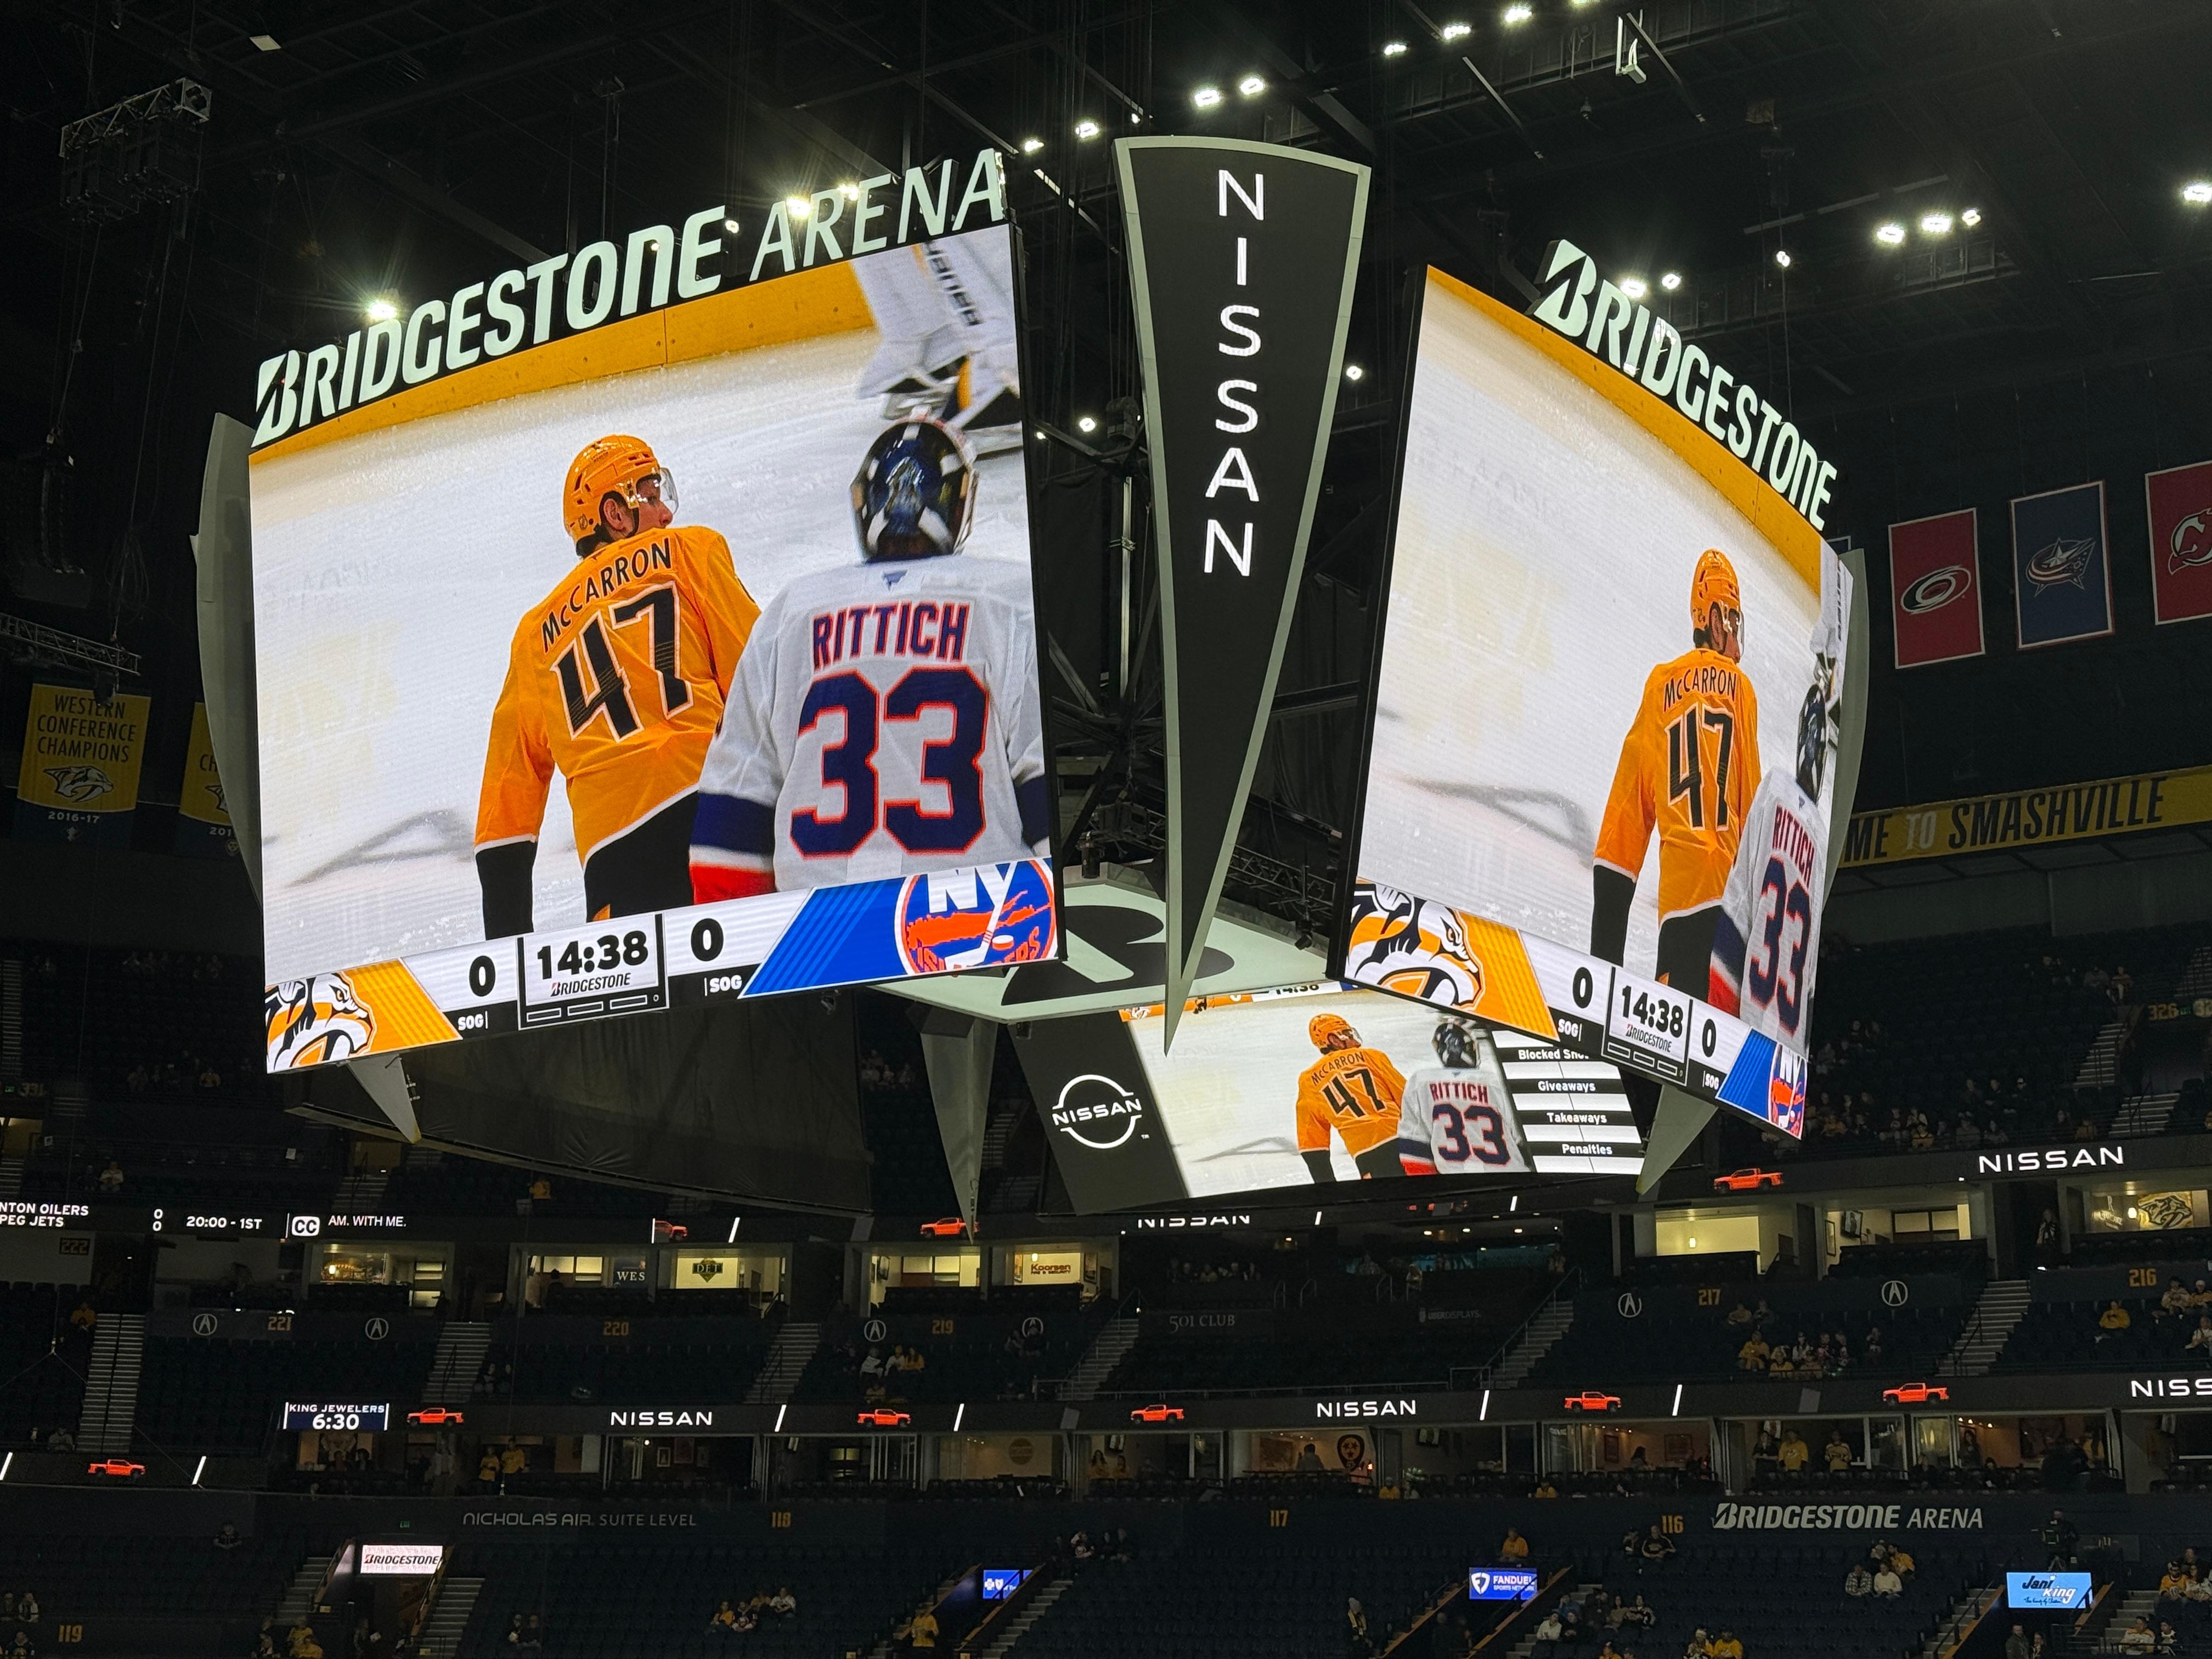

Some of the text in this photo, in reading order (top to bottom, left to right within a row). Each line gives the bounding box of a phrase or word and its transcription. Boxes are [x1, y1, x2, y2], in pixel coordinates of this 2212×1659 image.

[251, 206, 726, 448] BRIDGESTONE
[749, 148, 1005, 282] ARENA
[1204, 170, 1265, 577] NISSAN
[1531, 239, 1837, 531] BRIDGESTONE
[812, 601, 970, 670] RITTICH
[551, 581, 693, 741] 47
[37, 714, 137, 741] CONFERENCE
[37, 737, 130, 762] CHAMPIONS
[790, 665, 989, 859] 33
[1664, 702, 1734, 831] 47
[48, 811, 100, 823] 2016-17
[1905, 811, 1937, 851] TO
[1949, 776, 2168, 849] SMASHVILLE
[1772, 803, 1815, 889] RITTICH
[690, 918, 724, 962] 0
[1749, 854, 1810, 1037] 33
[537, 931, 648, 980] 14:38
[469, 956, 495, 997] 0
[550, 973, 631, 997] BRIDGESTONE
[709, 975, 742, 993] SOG
[1572, 967, 1593, 1008] 0
[1622, 985, 1683, 1038] 14:38
[2148, 1003, 2180, 1021] 326
[458, 1015, 483, 1031] SOG
[1558, 1019, 1579, 1037] SOG
[1626, 1024, 1672, 1053] BRIDGESTONE
[1702, 1019, 1717, 1058] 0
[1518, 1049, 1560, 1060] Blocked
[1538, 1080, 1596, 1093] Giveaways
[1705, 1073, 1719, 1090] SOG
[1318, 1066, 1387, 1120] 47
[1430, 1081, 1489, 1105] RITTICH
[1052, 1098, 1142, 1126] NISSAN
[1547, 1112, 1607, 1125] Takeaways
[1432, 1103, 1511, 1166] 33
[1562, 1144, 1613, 1155] Penalties
[1978, 1146, 2125, 1174] NISSAN
[0, 1202, 163, 1219] NTON OILERS 0
[0, 1215, 162, 1232] PEG JETS 0
[186, 1216, 227, 1228] 20:00
[240, 1218, 262, 1230] 1ST
[294, 1218, 318, 1234] CC
[328, 1215, 407, 1227] AM. WITH ME.
[2129, 1268, 2157, 1287] 216
[1698, 1288, 1721, 1306] 217
[268, 1317, 292, 1331] 221
[603, 1321, 629, 1336] 220
[933, 1319, 954, 1335] 219
[1199, 1314, 1235, 1327] CLUB
[321, 1404, 385, 1413] JEWELERS
[1317, 1400, 1417, 1418] NISSAN
[312, 1414, 359, 1430] 6:30
[610, 1411, 713, 1426] NISSAN
[462, 1513, 558, 1526] NICHOLAS
[599, 1514, 645, 1527] SUITE
[650, 1514, 697, 1527] LEVEL
[771, 1511, 792, 1528] 118
[1270, 1510, 1289, 1527] 117
[1661, 1514, 1684, 1534] 116
[1712, 1503, 1984, 1530] BRIDGESTONE ARENA
[364, 1554, 440, 1565] BRIDGESTONE
[1493, 1575, 1536, 1585] FANDUEL
[2022, 1574, 2057, 1589] Jani
[2042, 1586, 2076, 1605] king
[58, 1624, 83, 1644] 119
